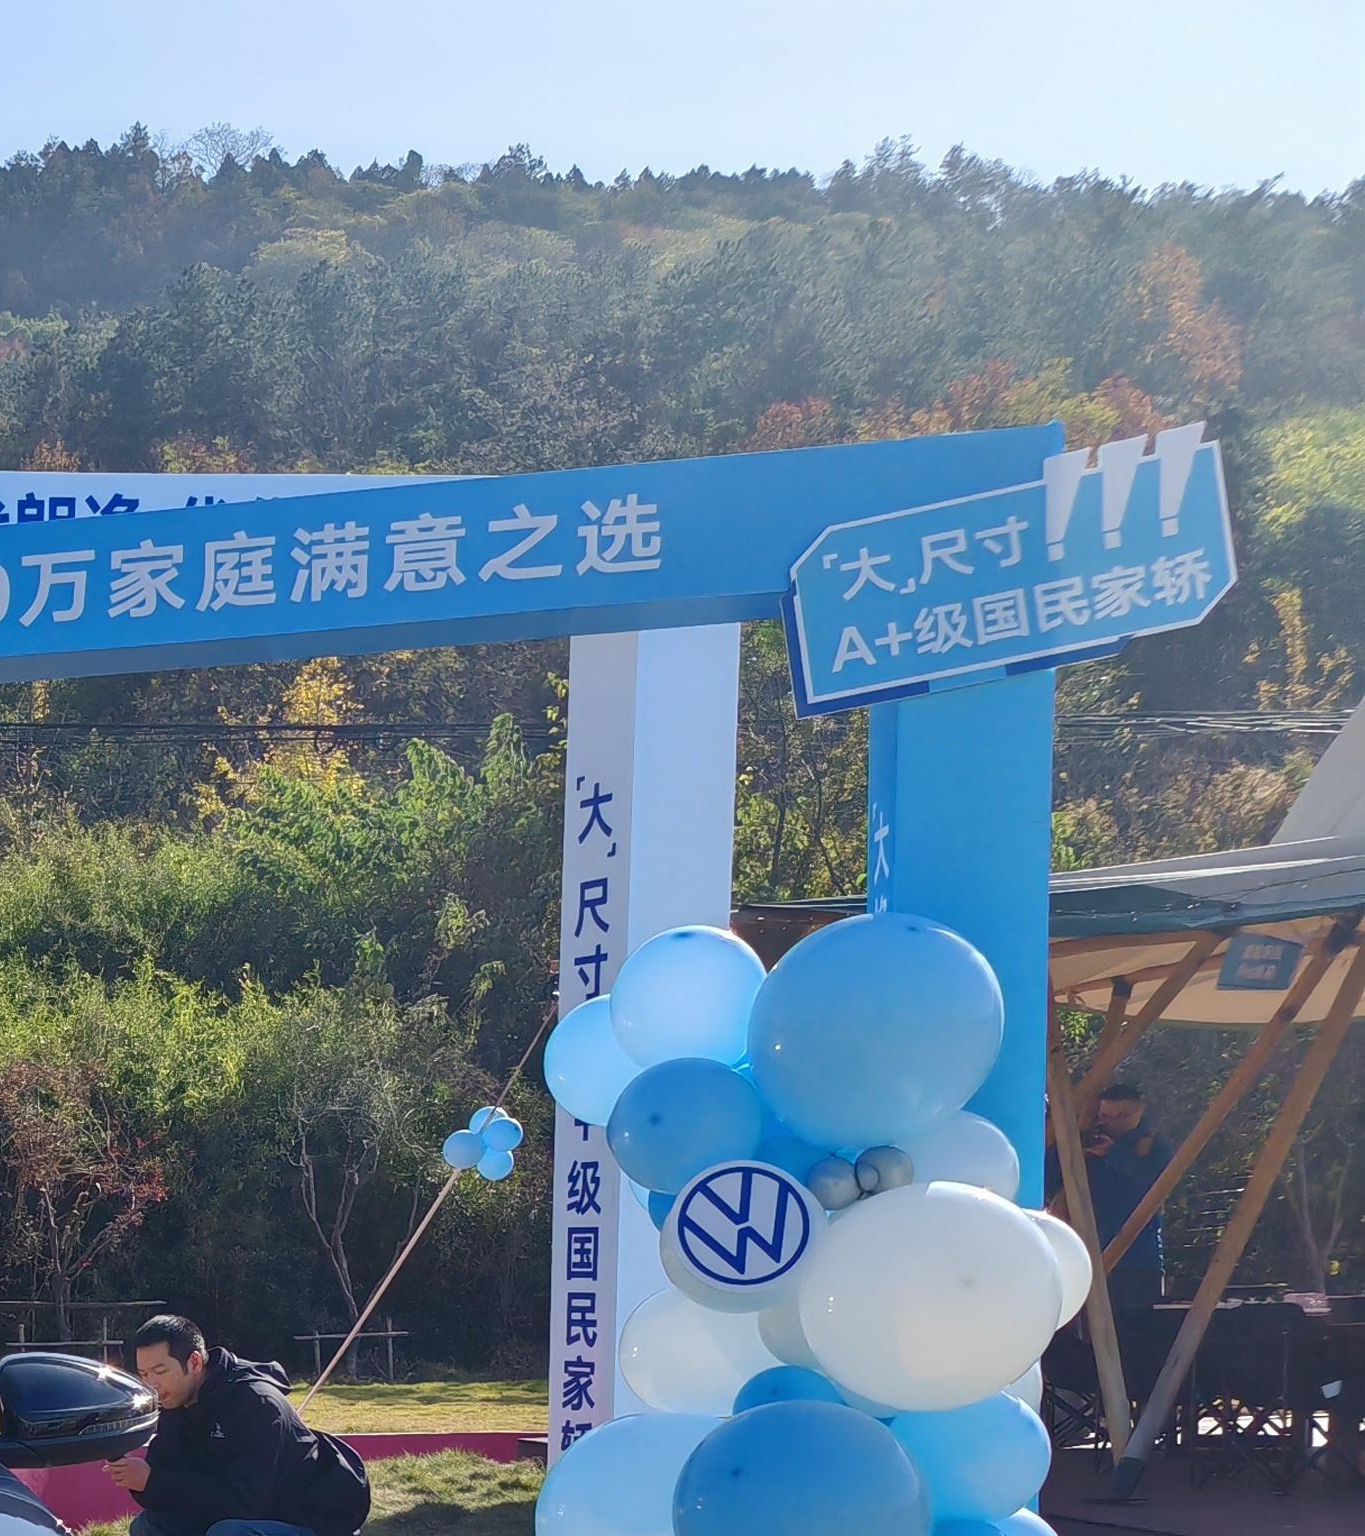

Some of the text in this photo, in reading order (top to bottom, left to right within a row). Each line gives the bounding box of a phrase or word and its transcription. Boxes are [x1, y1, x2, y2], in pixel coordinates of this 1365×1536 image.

[830, 548, 1213, 674] A+级国民家轿
